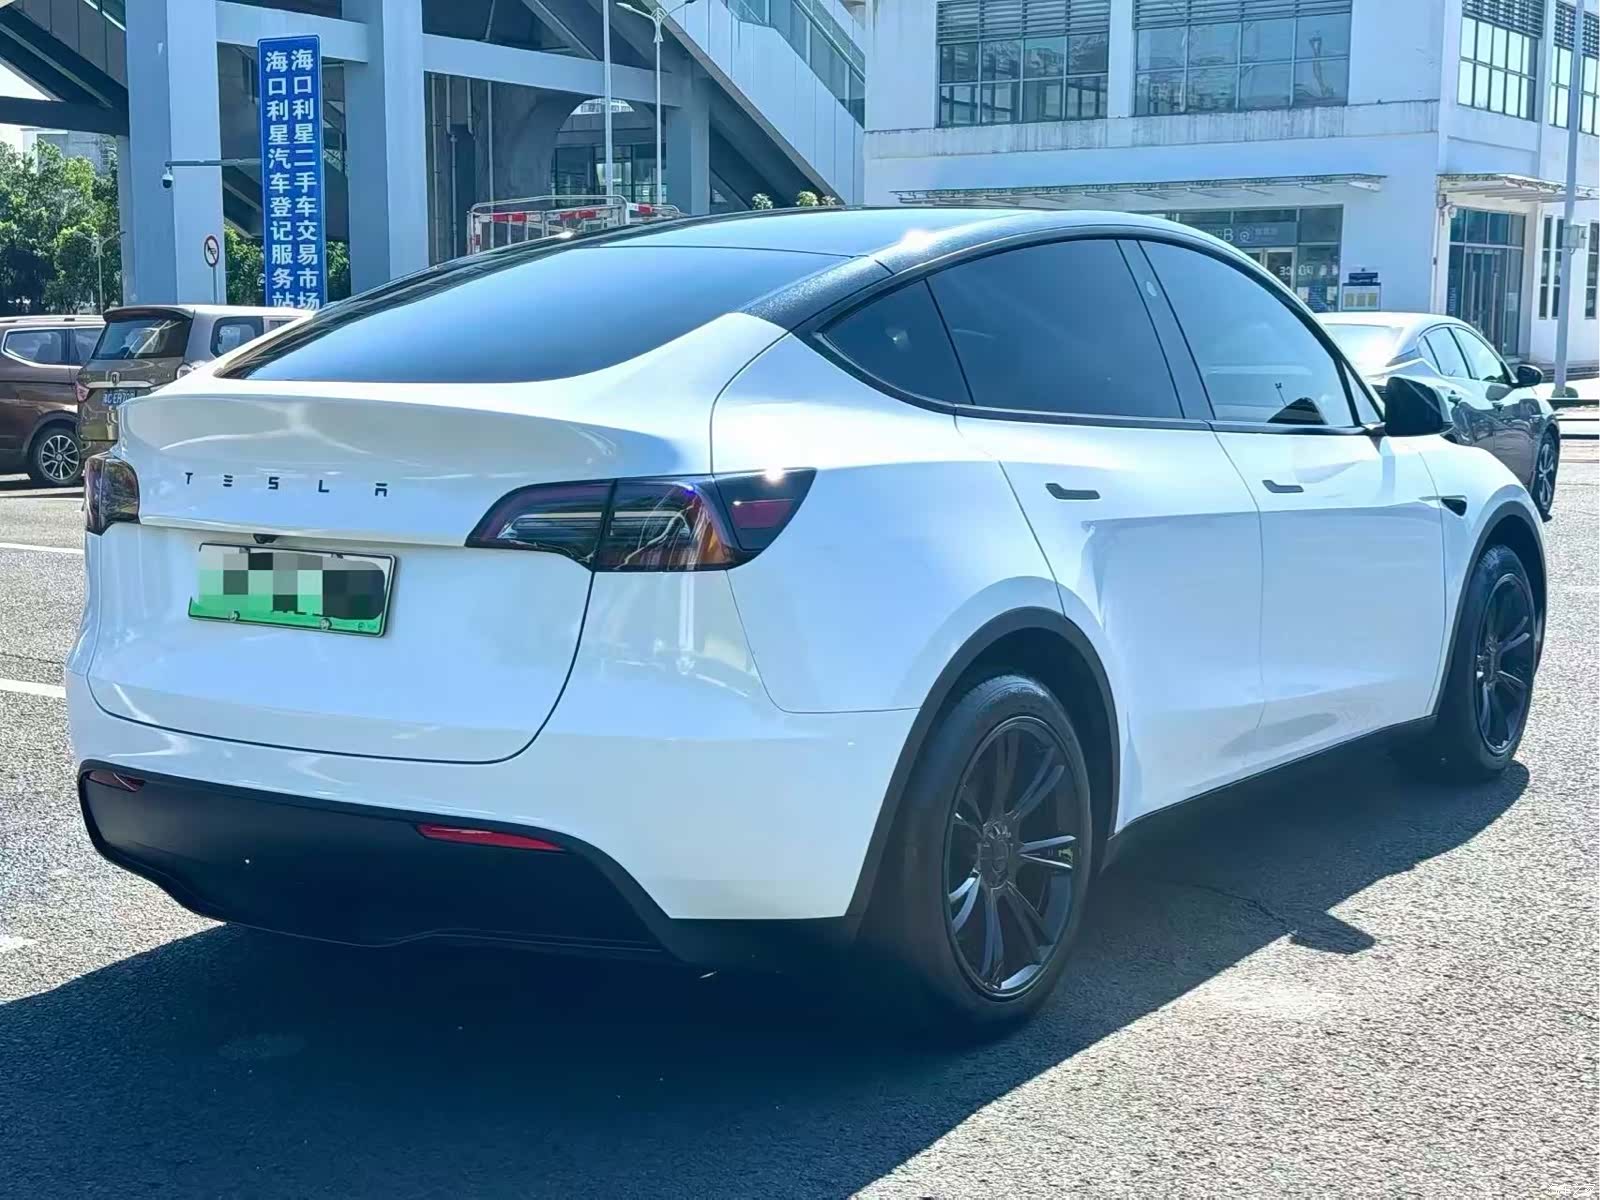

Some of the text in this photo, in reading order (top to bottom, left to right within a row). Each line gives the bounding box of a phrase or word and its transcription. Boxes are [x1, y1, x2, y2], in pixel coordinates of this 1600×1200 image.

[265, 50, 295, 308] 海口利星汽车登记服务站
[290, 48, 320, 311] 海口利星二手车交易市场
[185, 472, 388, 497] TESLA
